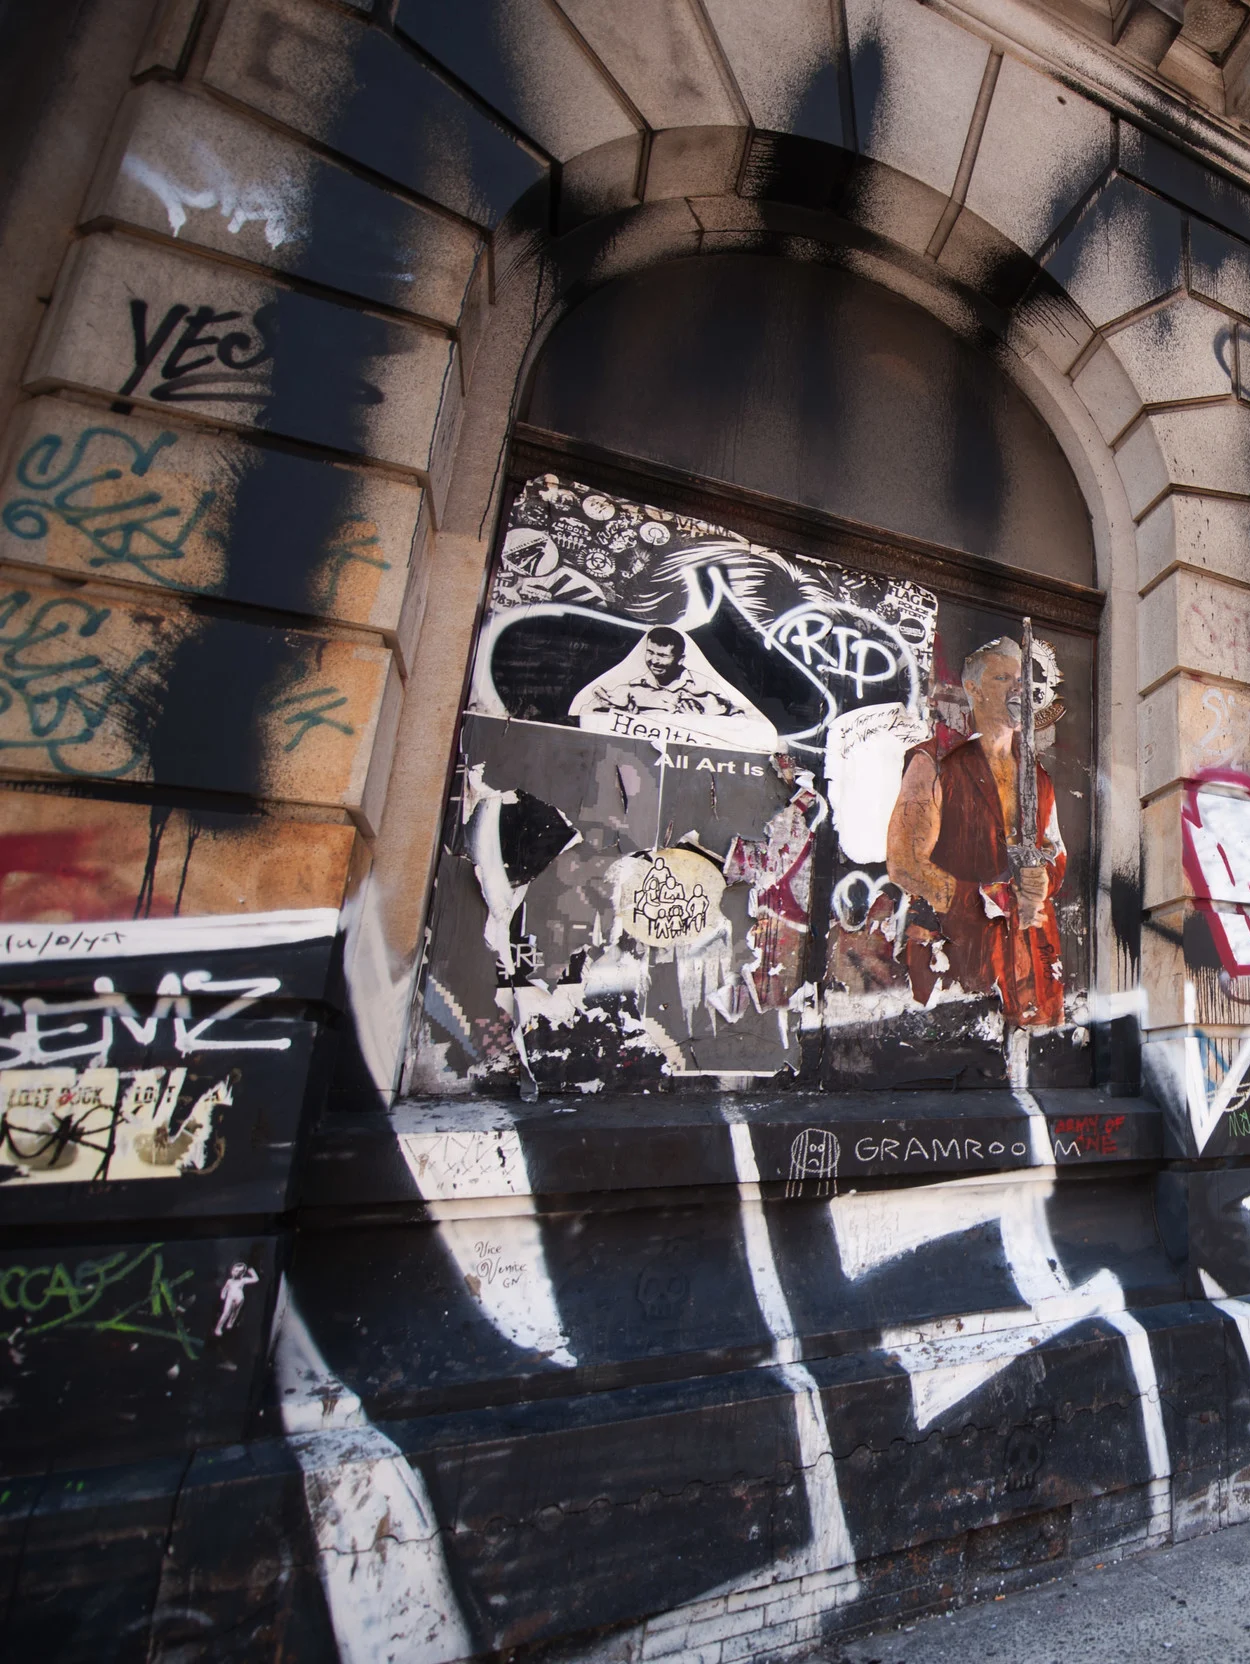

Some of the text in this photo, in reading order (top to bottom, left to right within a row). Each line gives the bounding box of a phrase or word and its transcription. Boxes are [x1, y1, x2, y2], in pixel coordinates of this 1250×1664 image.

[887, 587, 921, 605] FLAG
[898, 600, 930, 616] POLICE
[780, 612, 898, 698] RIP
[610, 712, 712, 745] Health
[654, 753, 765, 777] All Art Is
[1104, 1115, 1126, 1134] OF
